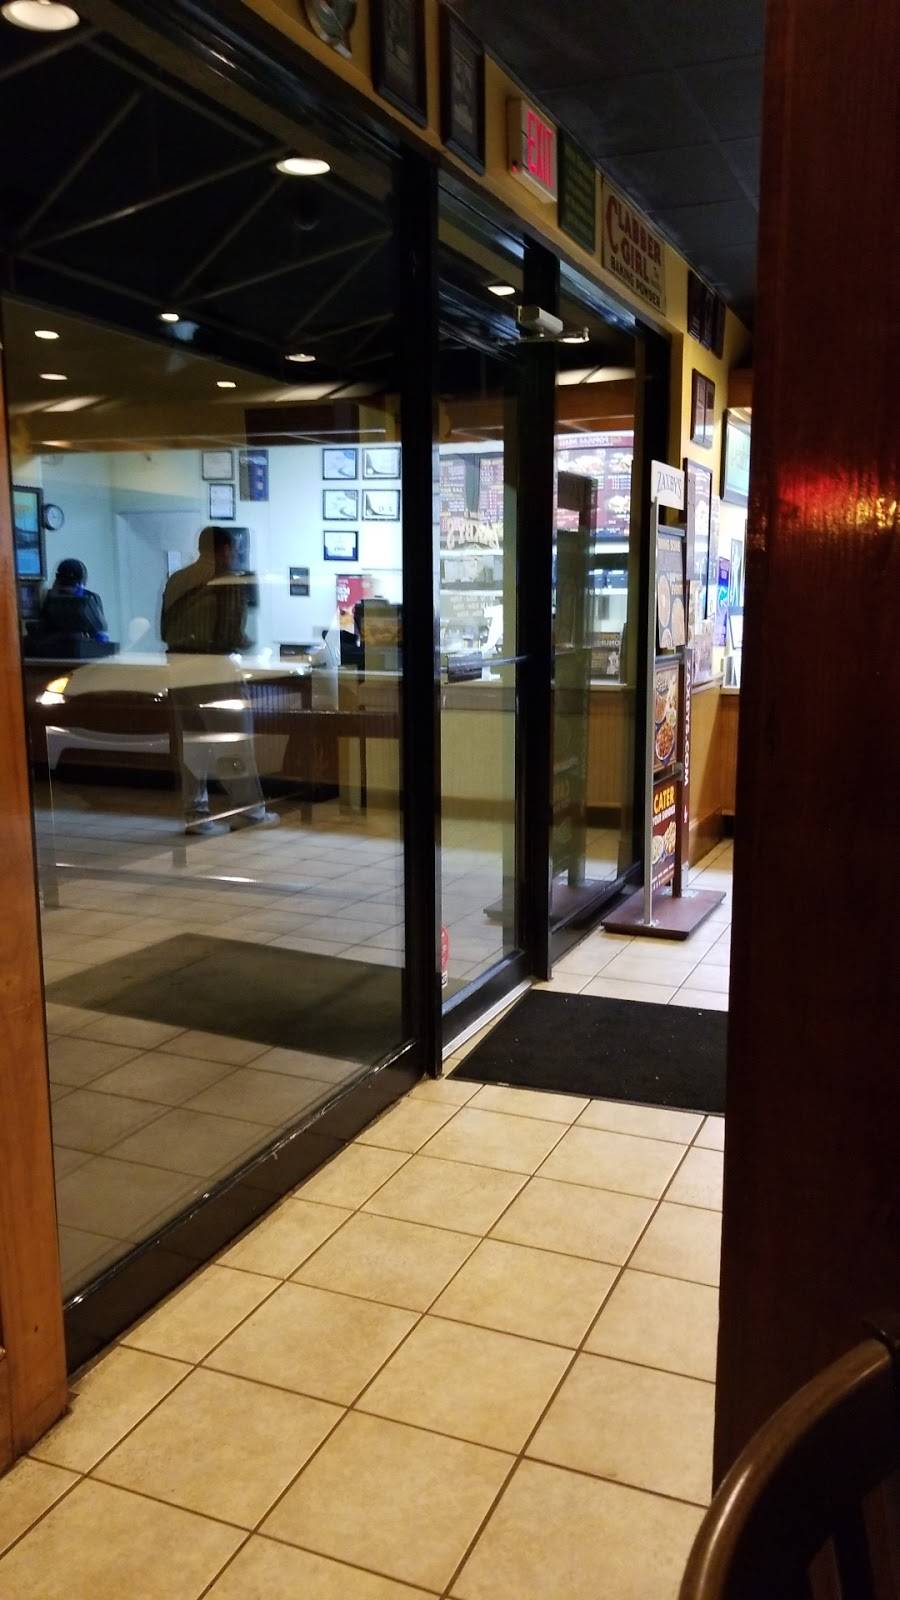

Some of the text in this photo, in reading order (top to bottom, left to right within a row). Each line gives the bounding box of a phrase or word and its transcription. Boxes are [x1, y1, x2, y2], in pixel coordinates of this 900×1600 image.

[527, 108, 554, 190] EXIT
[606, 195, 662, 268] CLABBER
[620, 237, 649, 284] GIRL
[635, 280, 661, 308] POWDER
[684, 659, 692, 787] ZAXBYS.COM
[653, 785, 675, 815] CATER
